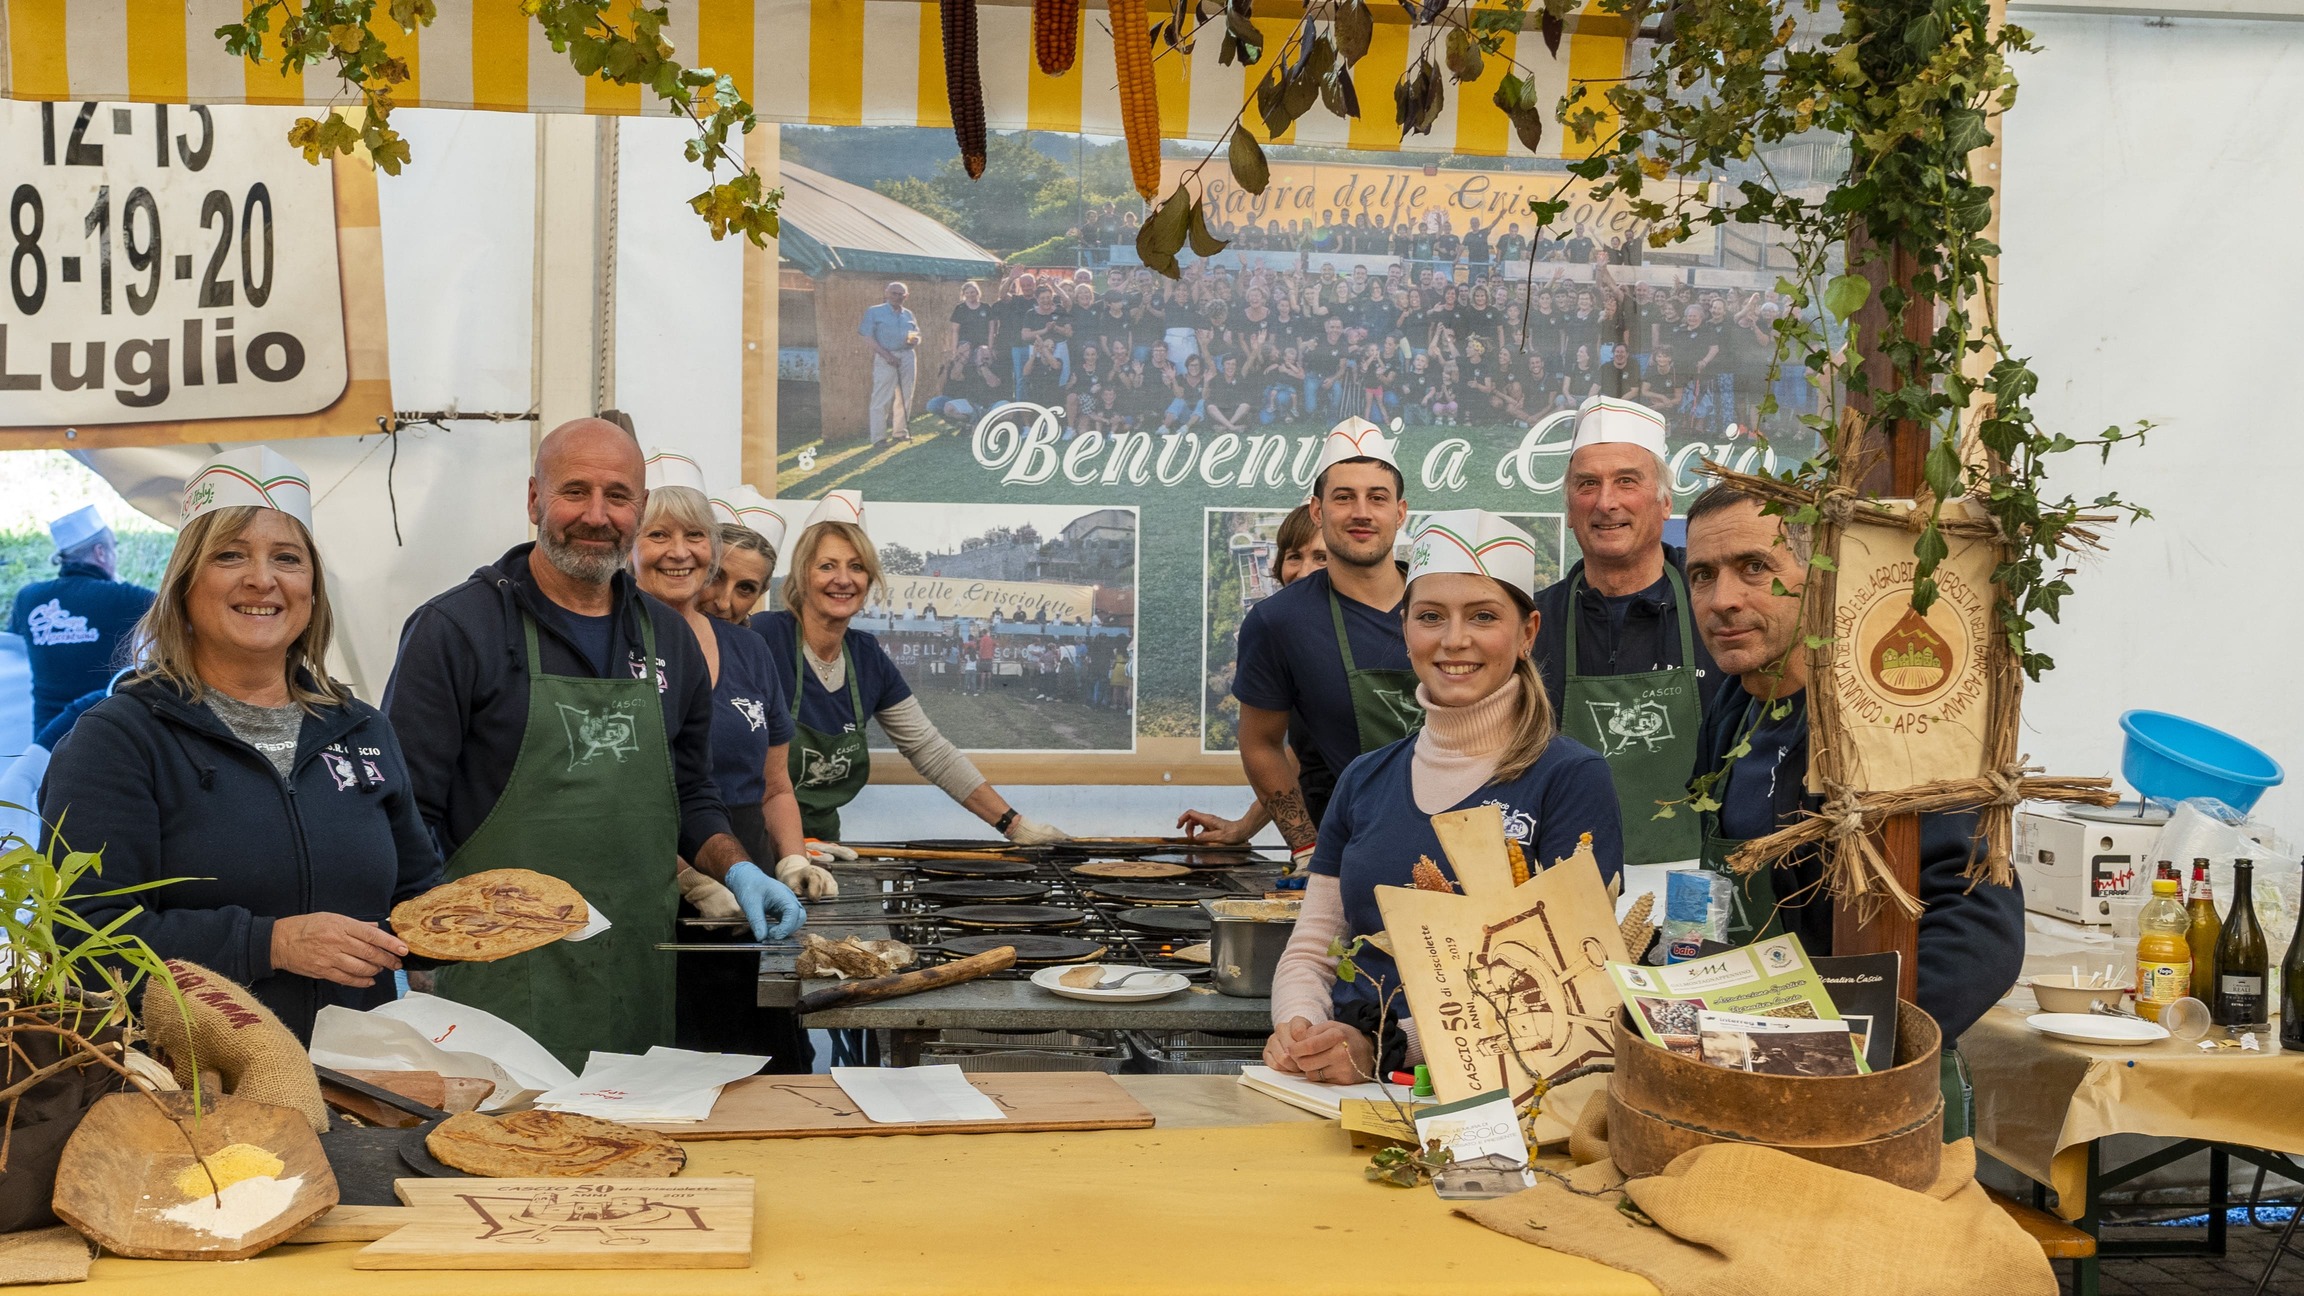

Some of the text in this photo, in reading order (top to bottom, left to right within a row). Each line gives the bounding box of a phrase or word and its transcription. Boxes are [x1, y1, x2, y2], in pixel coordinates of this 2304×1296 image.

[1204, 177, 1316, 221] Sagra
[1333, 173, 1428, 211] delle
[0, 316, 306, 408] Luglio
[971, 401, 1405, 493] Benvenui
[1421, 437, 1473, 492] a
[904, 581, 953, 600] delle
[963, 582, 1075, 617] Crisciolette
[1849, 599, 1862, 611] E
[1970, 616, 1986, 643] DELLA
[1642, 686, 1682, 698] CASCIO
[1938, 644, 1990, 722] GARFAGNANA
[1893, 712, 1929, 734] APS
[2093, 868, 2135, 891] trippa
[1445, 936, 1461, 961] 2019
[1856, 974, 1883, 984] Cascio
[1421, 924, 1482, 1091] CASCIO 50 di Crisciolette
[1466, 1001, 1482, 1030] ANNI
[1437, 1122, 1510, 1145] CASCIO
[574, 1184, 614, 1193] 50
